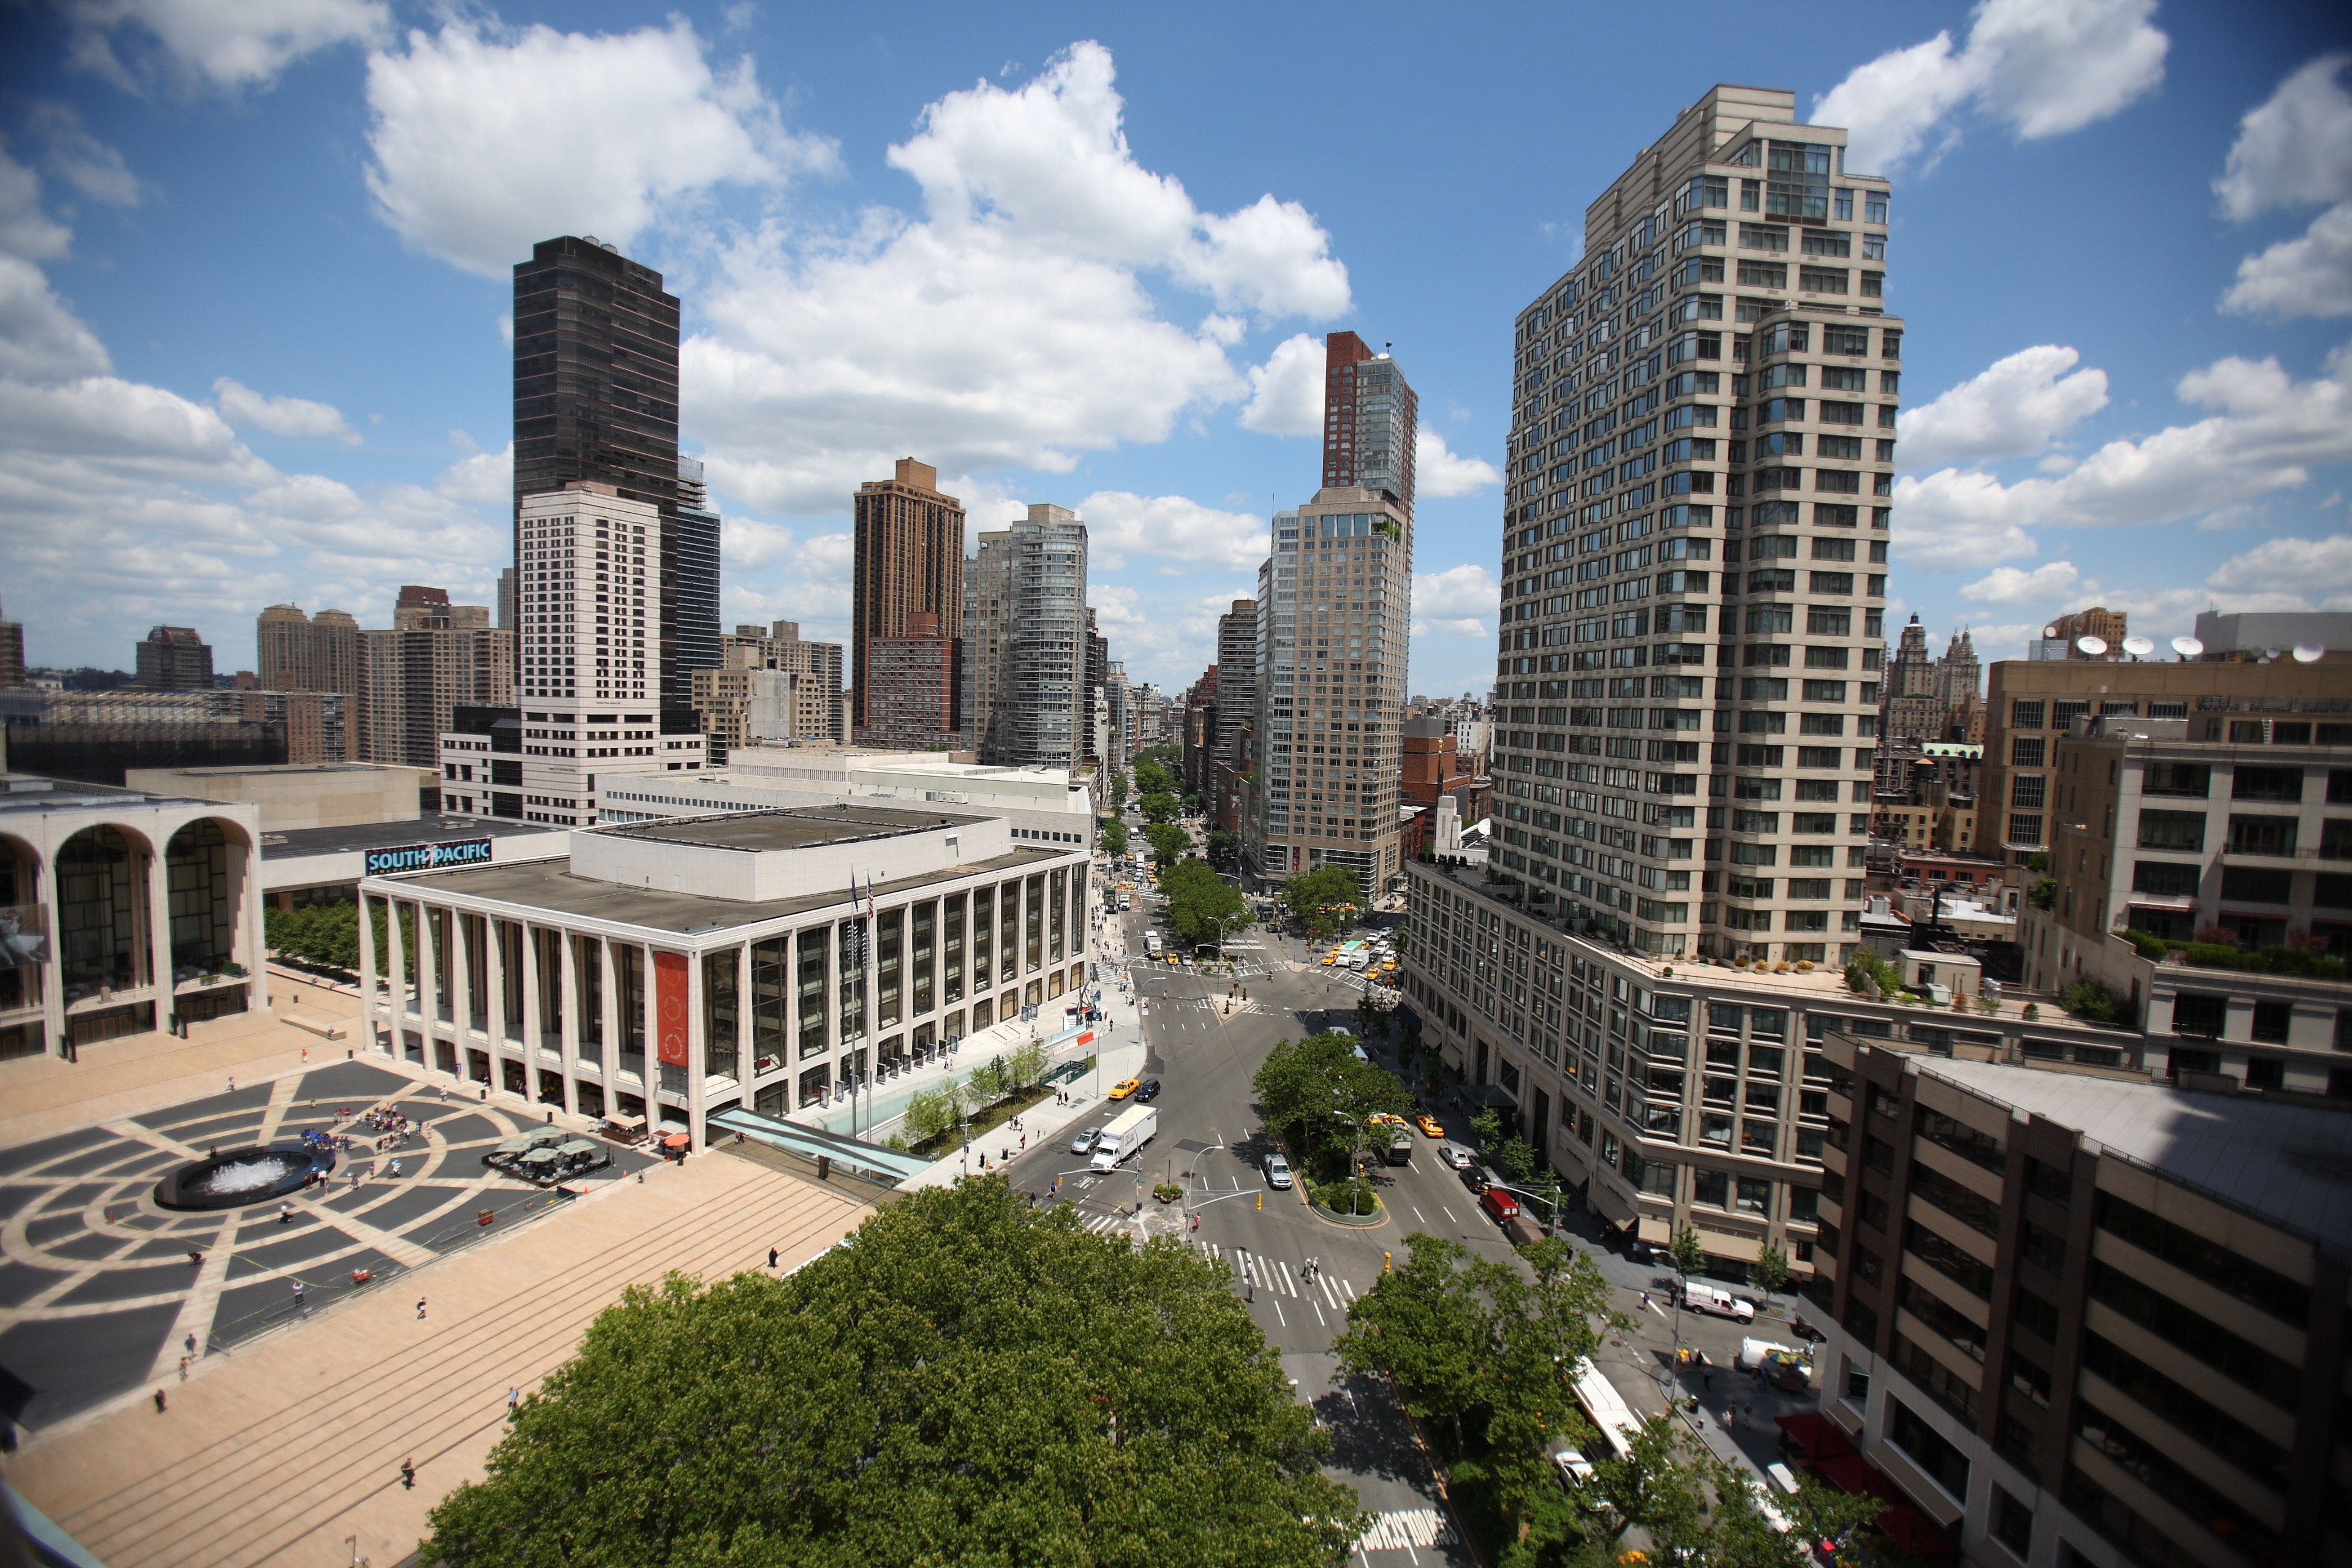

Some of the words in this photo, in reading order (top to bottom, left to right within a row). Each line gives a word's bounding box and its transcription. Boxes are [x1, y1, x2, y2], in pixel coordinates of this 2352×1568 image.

[369, 850, 427, 870] SOUTH
[435, 843, 490, 862] PACIFIC
[369, 866, 410, 875] LINCOLN
[454, 857, 490, 865] THEATER
